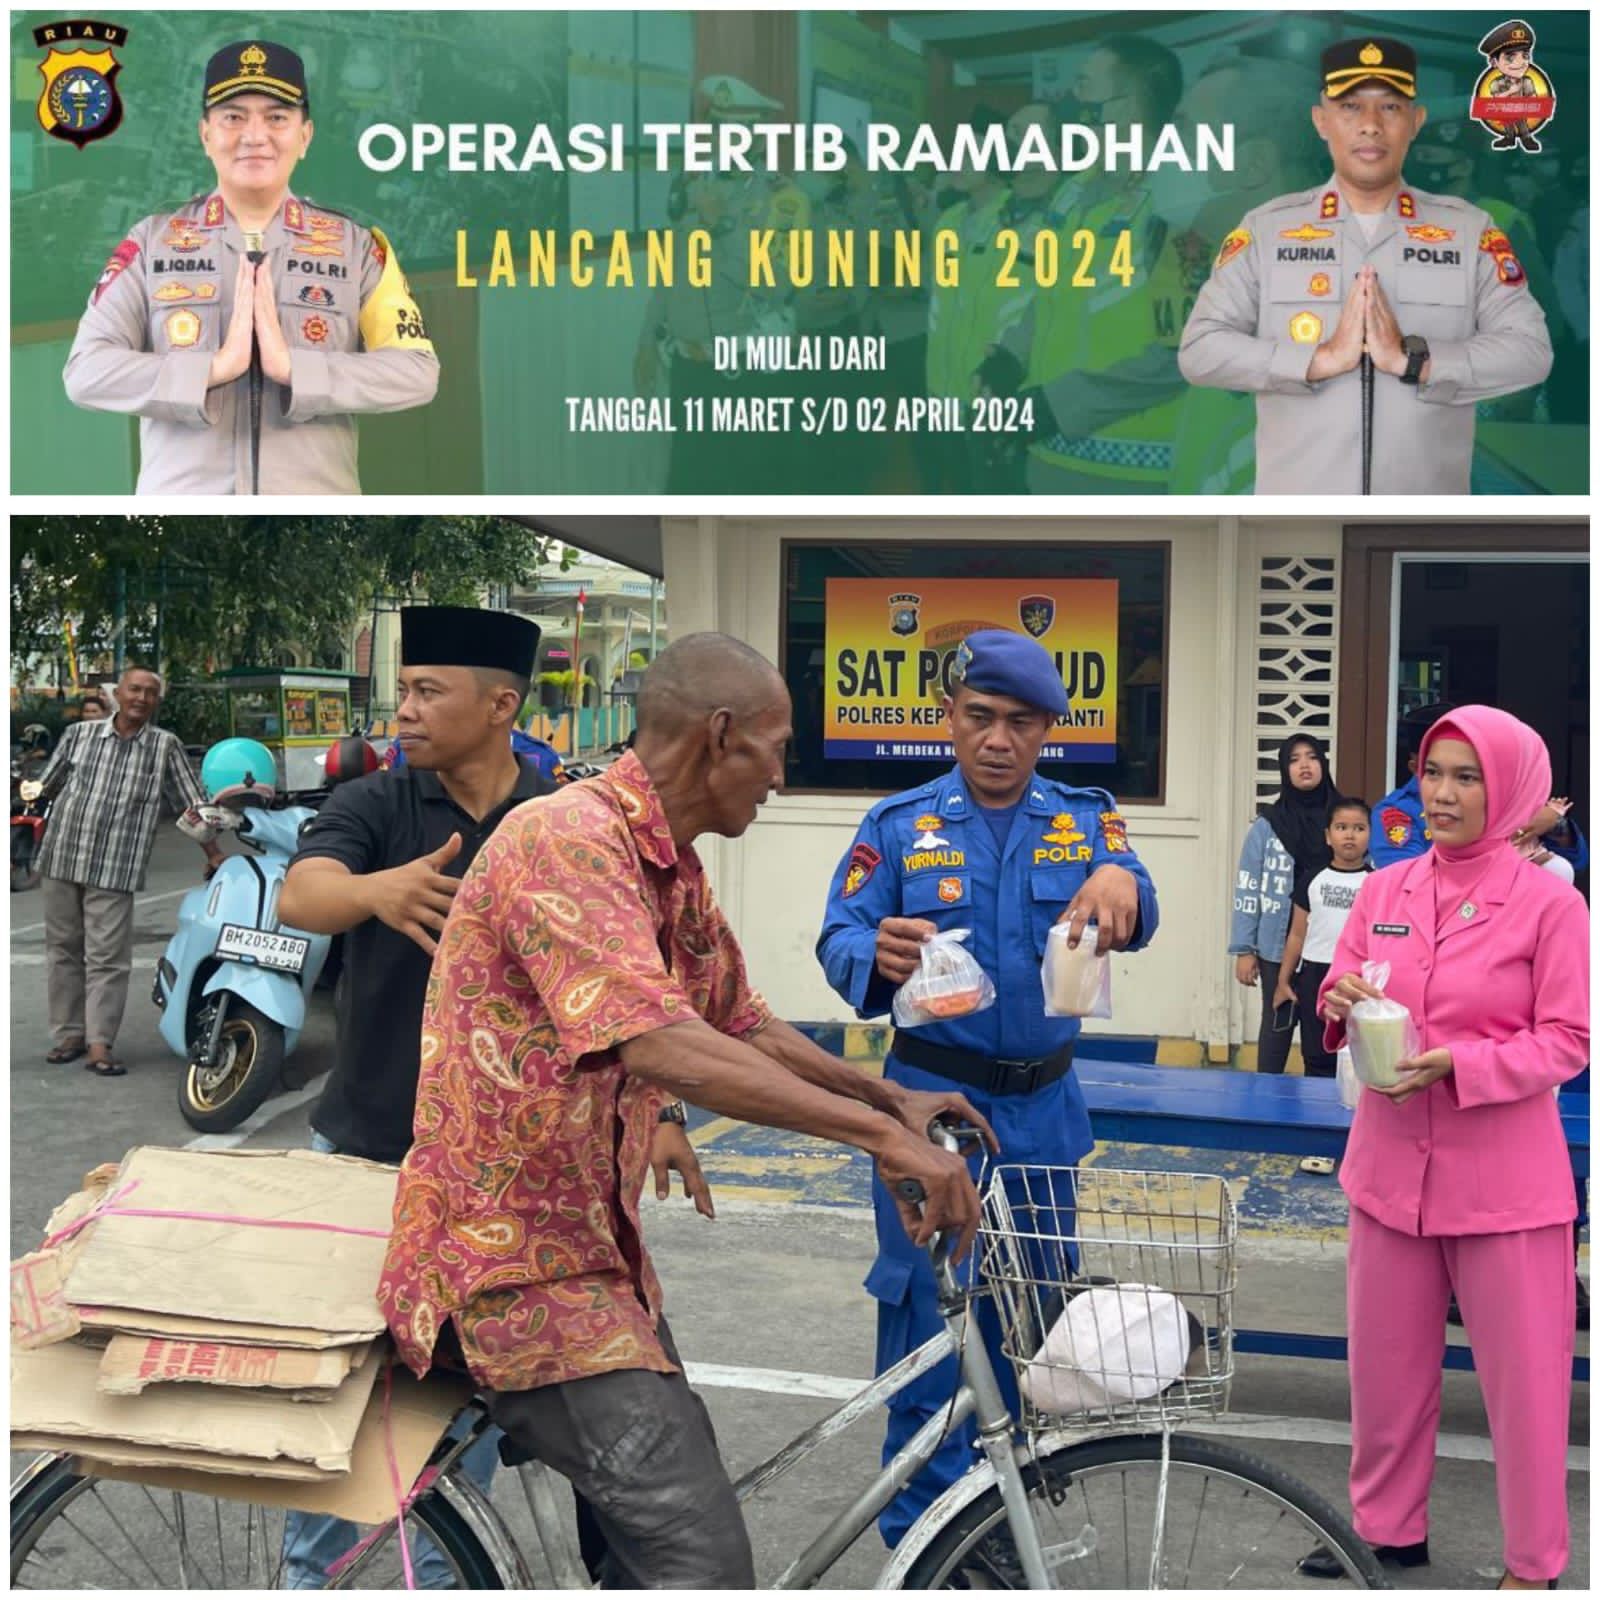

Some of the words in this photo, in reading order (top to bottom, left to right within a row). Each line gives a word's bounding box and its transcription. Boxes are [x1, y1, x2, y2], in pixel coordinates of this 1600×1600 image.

[1277, 247, 1337, 263] KURNIA
[1403, 247, 1461, 265] POLRI
[286, 258, 348, 279] POLRI
[837, 649, 905, 698] SAT
[837, 706, 905, 725] POLRES
[876, 744, 890, 756] JL.
[892, 745, 942, 757] MERDEKA
[903, 851, 965, 873] YURNALDI
[225, 929, 244, 946] BM
[244, 933, 278, 951] 2052
